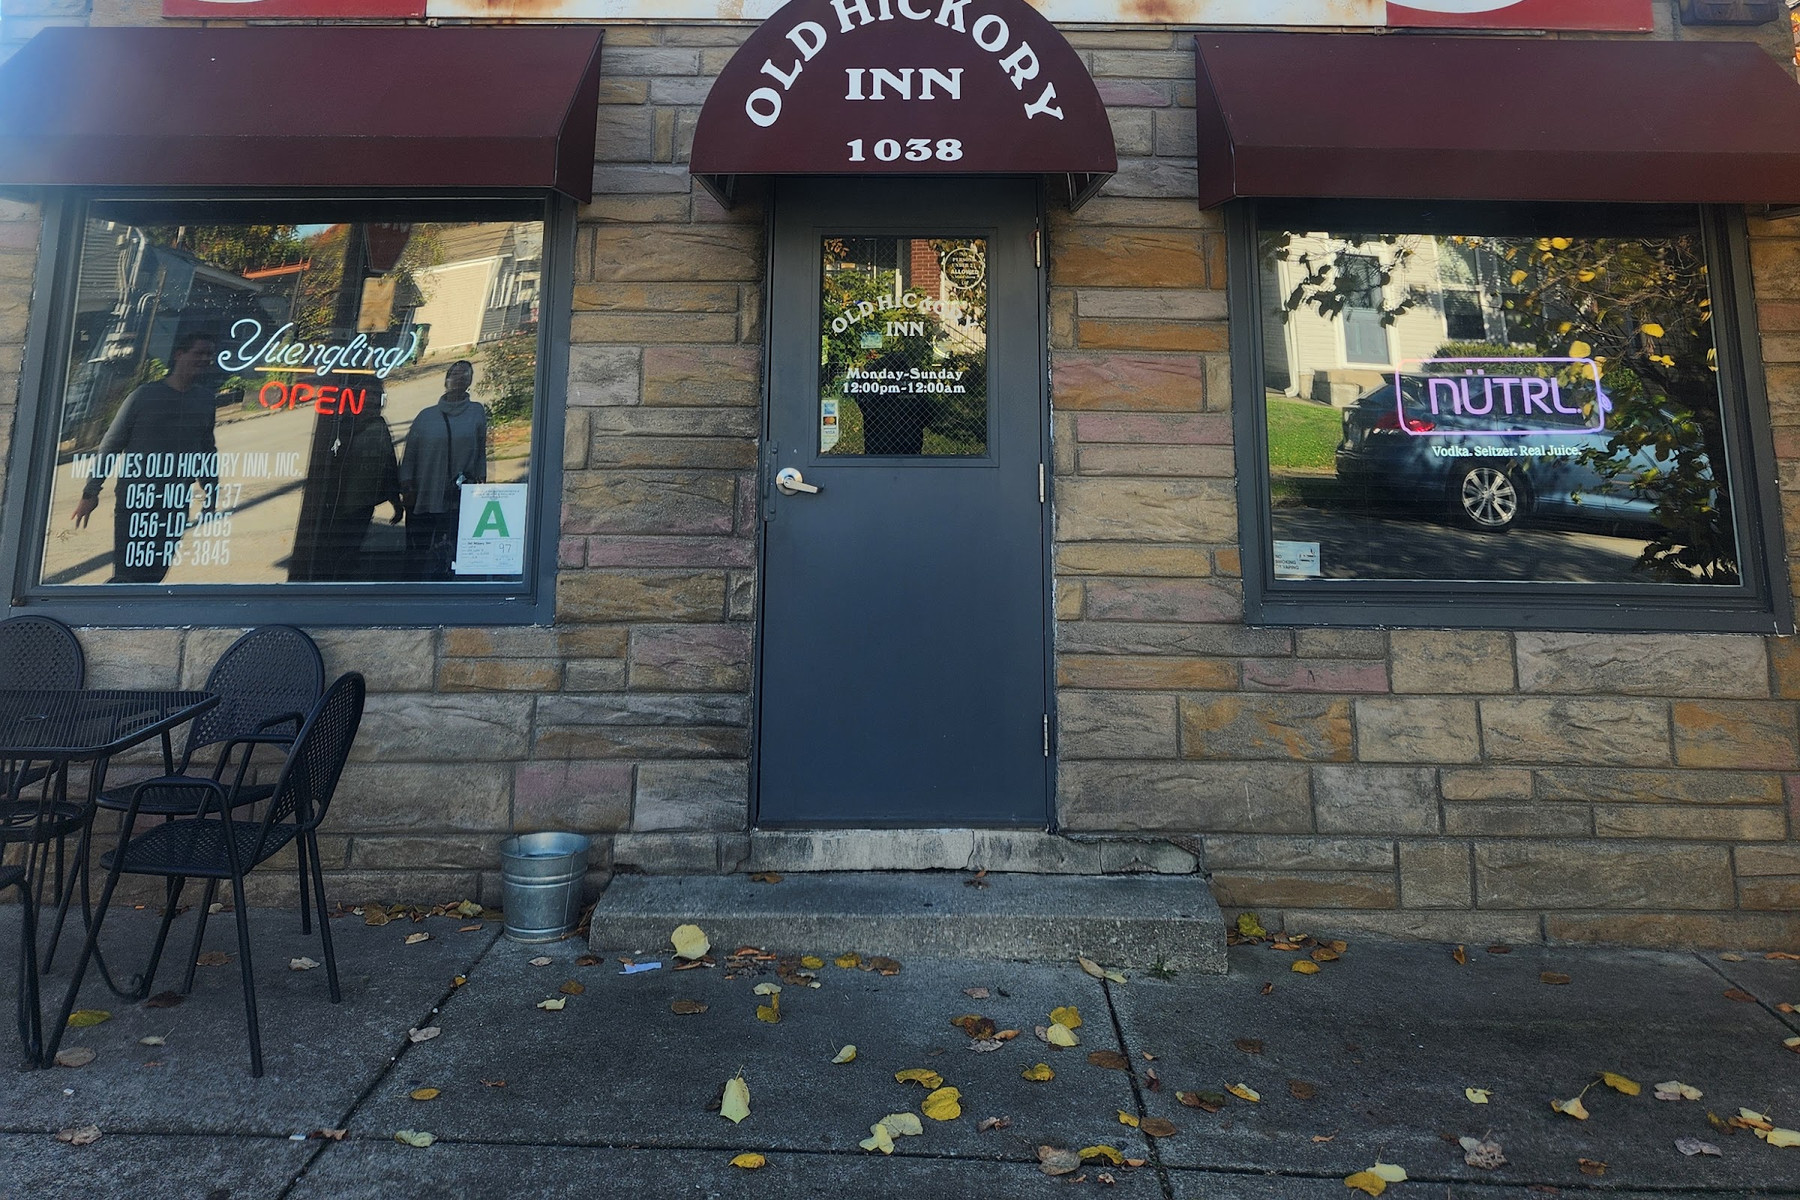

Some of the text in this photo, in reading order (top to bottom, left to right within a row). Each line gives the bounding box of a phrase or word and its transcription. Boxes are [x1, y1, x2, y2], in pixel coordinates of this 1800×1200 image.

[745, 20, 827, 127] OLD
[845, 68, 964, 100] INN
[847, 138, 963, 162] 1038
[831, 292, 979, 333] OLD HICKORY
[886, 321, 924, 337] INN
[217, 318, 418, 379] Yuengling
[846, 368, 963, 380] Monday-Sunday
[258, 380, 367, 415] OPEN
[843, 382, 966, 395] 12:00pm-12:00am
[1432, 445, 1582, 457] Vodka. Seltzer. Real Juice.
[71, 452, 303, 480] MALONES OLD HICKORY INN, INC.
[472, 500, 510, 538] A
[125, 539, 231, 567] 056-RS-3845
[499, 543, 512, 553] 97
